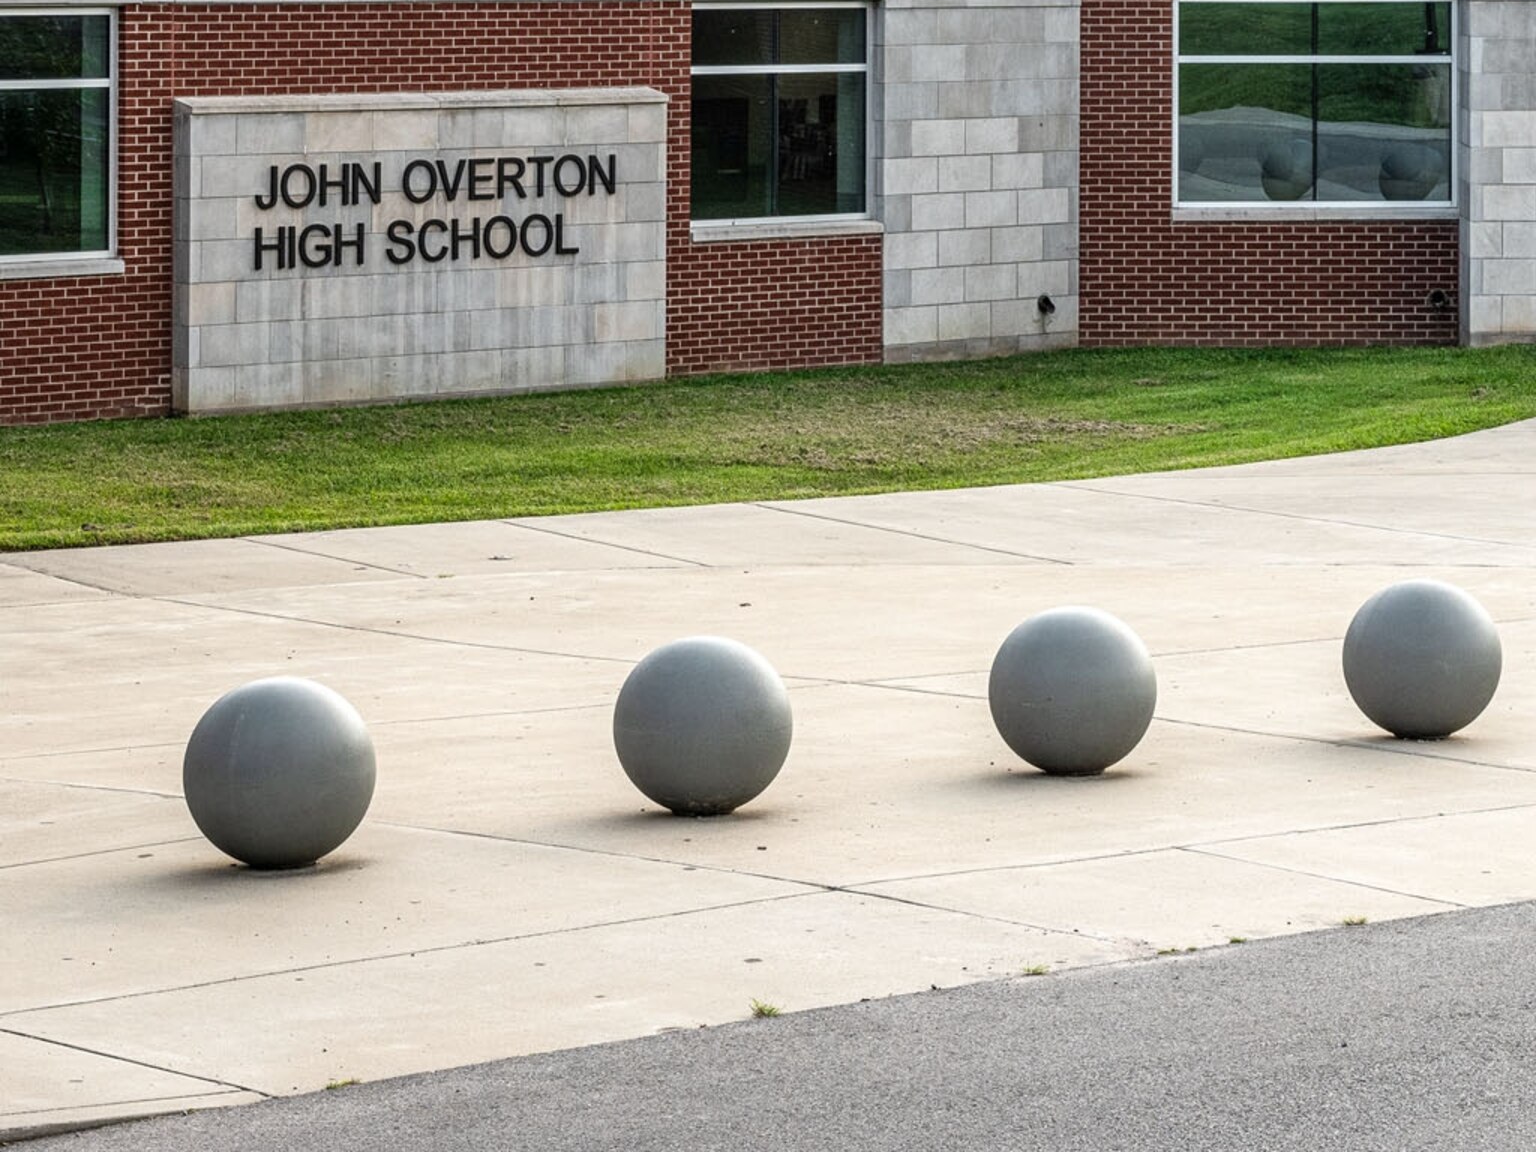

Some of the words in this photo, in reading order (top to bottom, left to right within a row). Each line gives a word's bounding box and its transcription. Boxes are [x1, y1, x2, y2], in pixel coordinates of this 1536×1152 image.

[255, 161, 381, 210] JOHN
[402, 154, 616, 204] OVERTON
[254, 223, 364, 270] HIGH
[386, 214, 579, 264] SCHOOL
